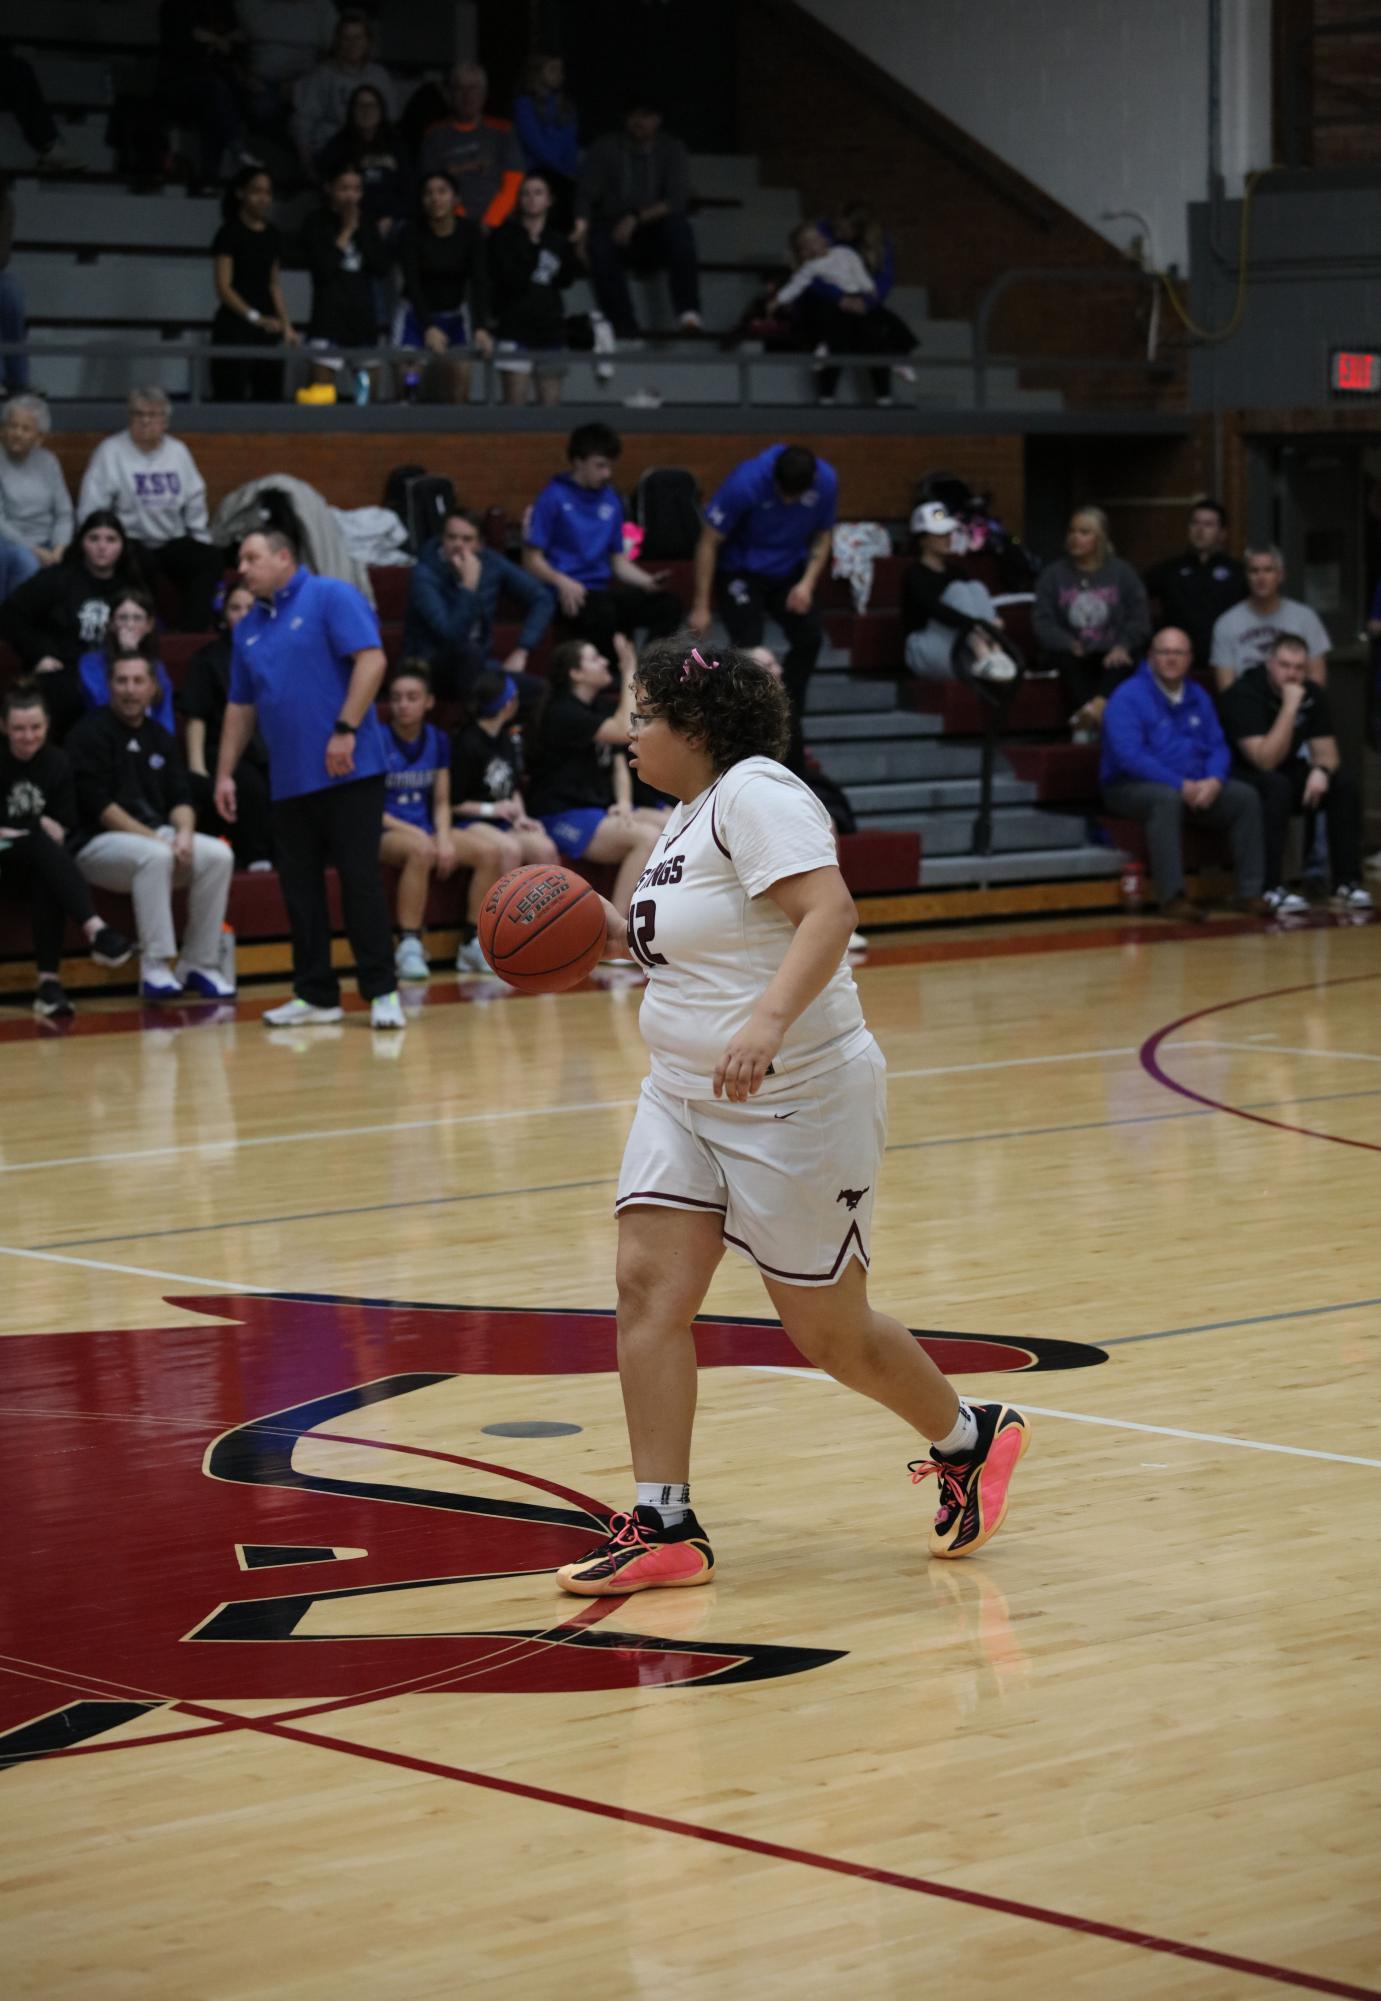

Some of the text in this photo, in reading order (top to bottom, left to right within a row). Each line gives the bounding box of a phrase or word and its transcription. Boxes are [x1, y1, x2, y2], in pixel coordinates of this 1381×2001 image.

[1337, 352, 1372, 389] EXIT
[133, 472, 181, 496] KSU
[507, 873, 567, 924] LEGACY
